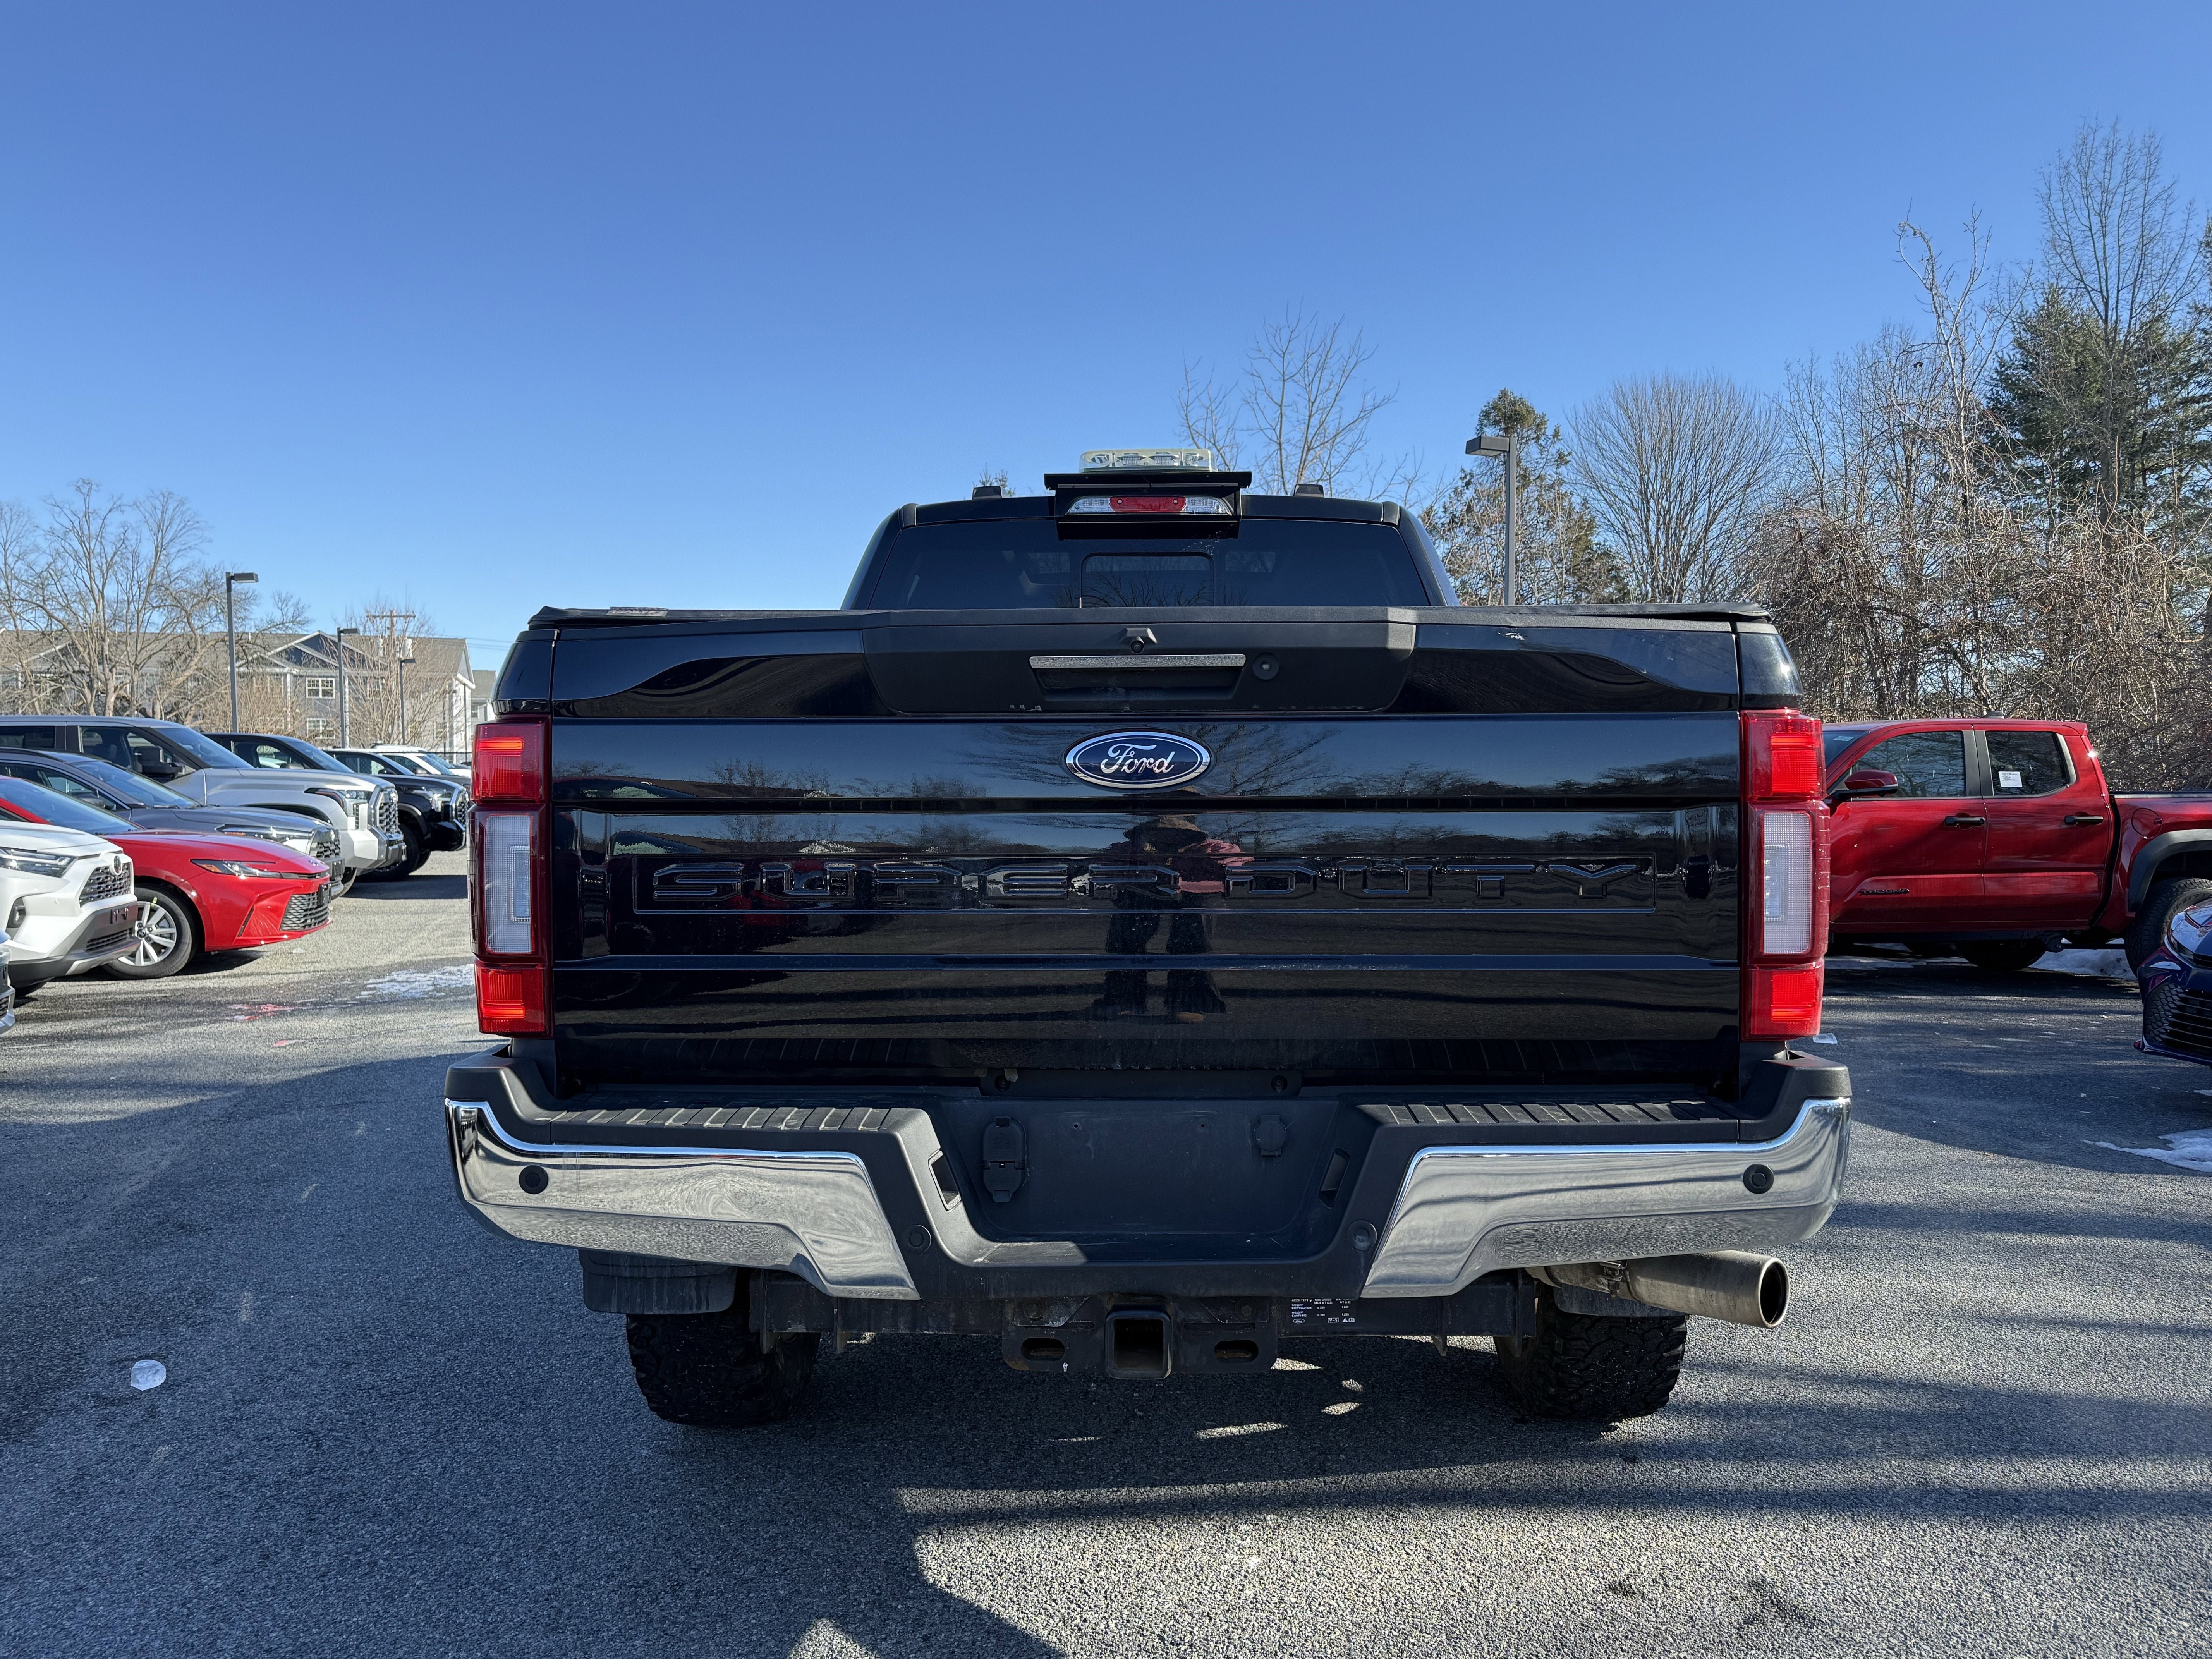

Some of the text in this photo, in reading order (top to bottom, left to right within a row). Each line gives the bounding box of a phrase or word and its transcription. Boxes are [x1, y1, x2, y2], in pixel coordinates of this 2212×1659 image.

[1100, 743, 1176, 774] Ford
[653, 863, 1637, 901] SUPER DUTY
